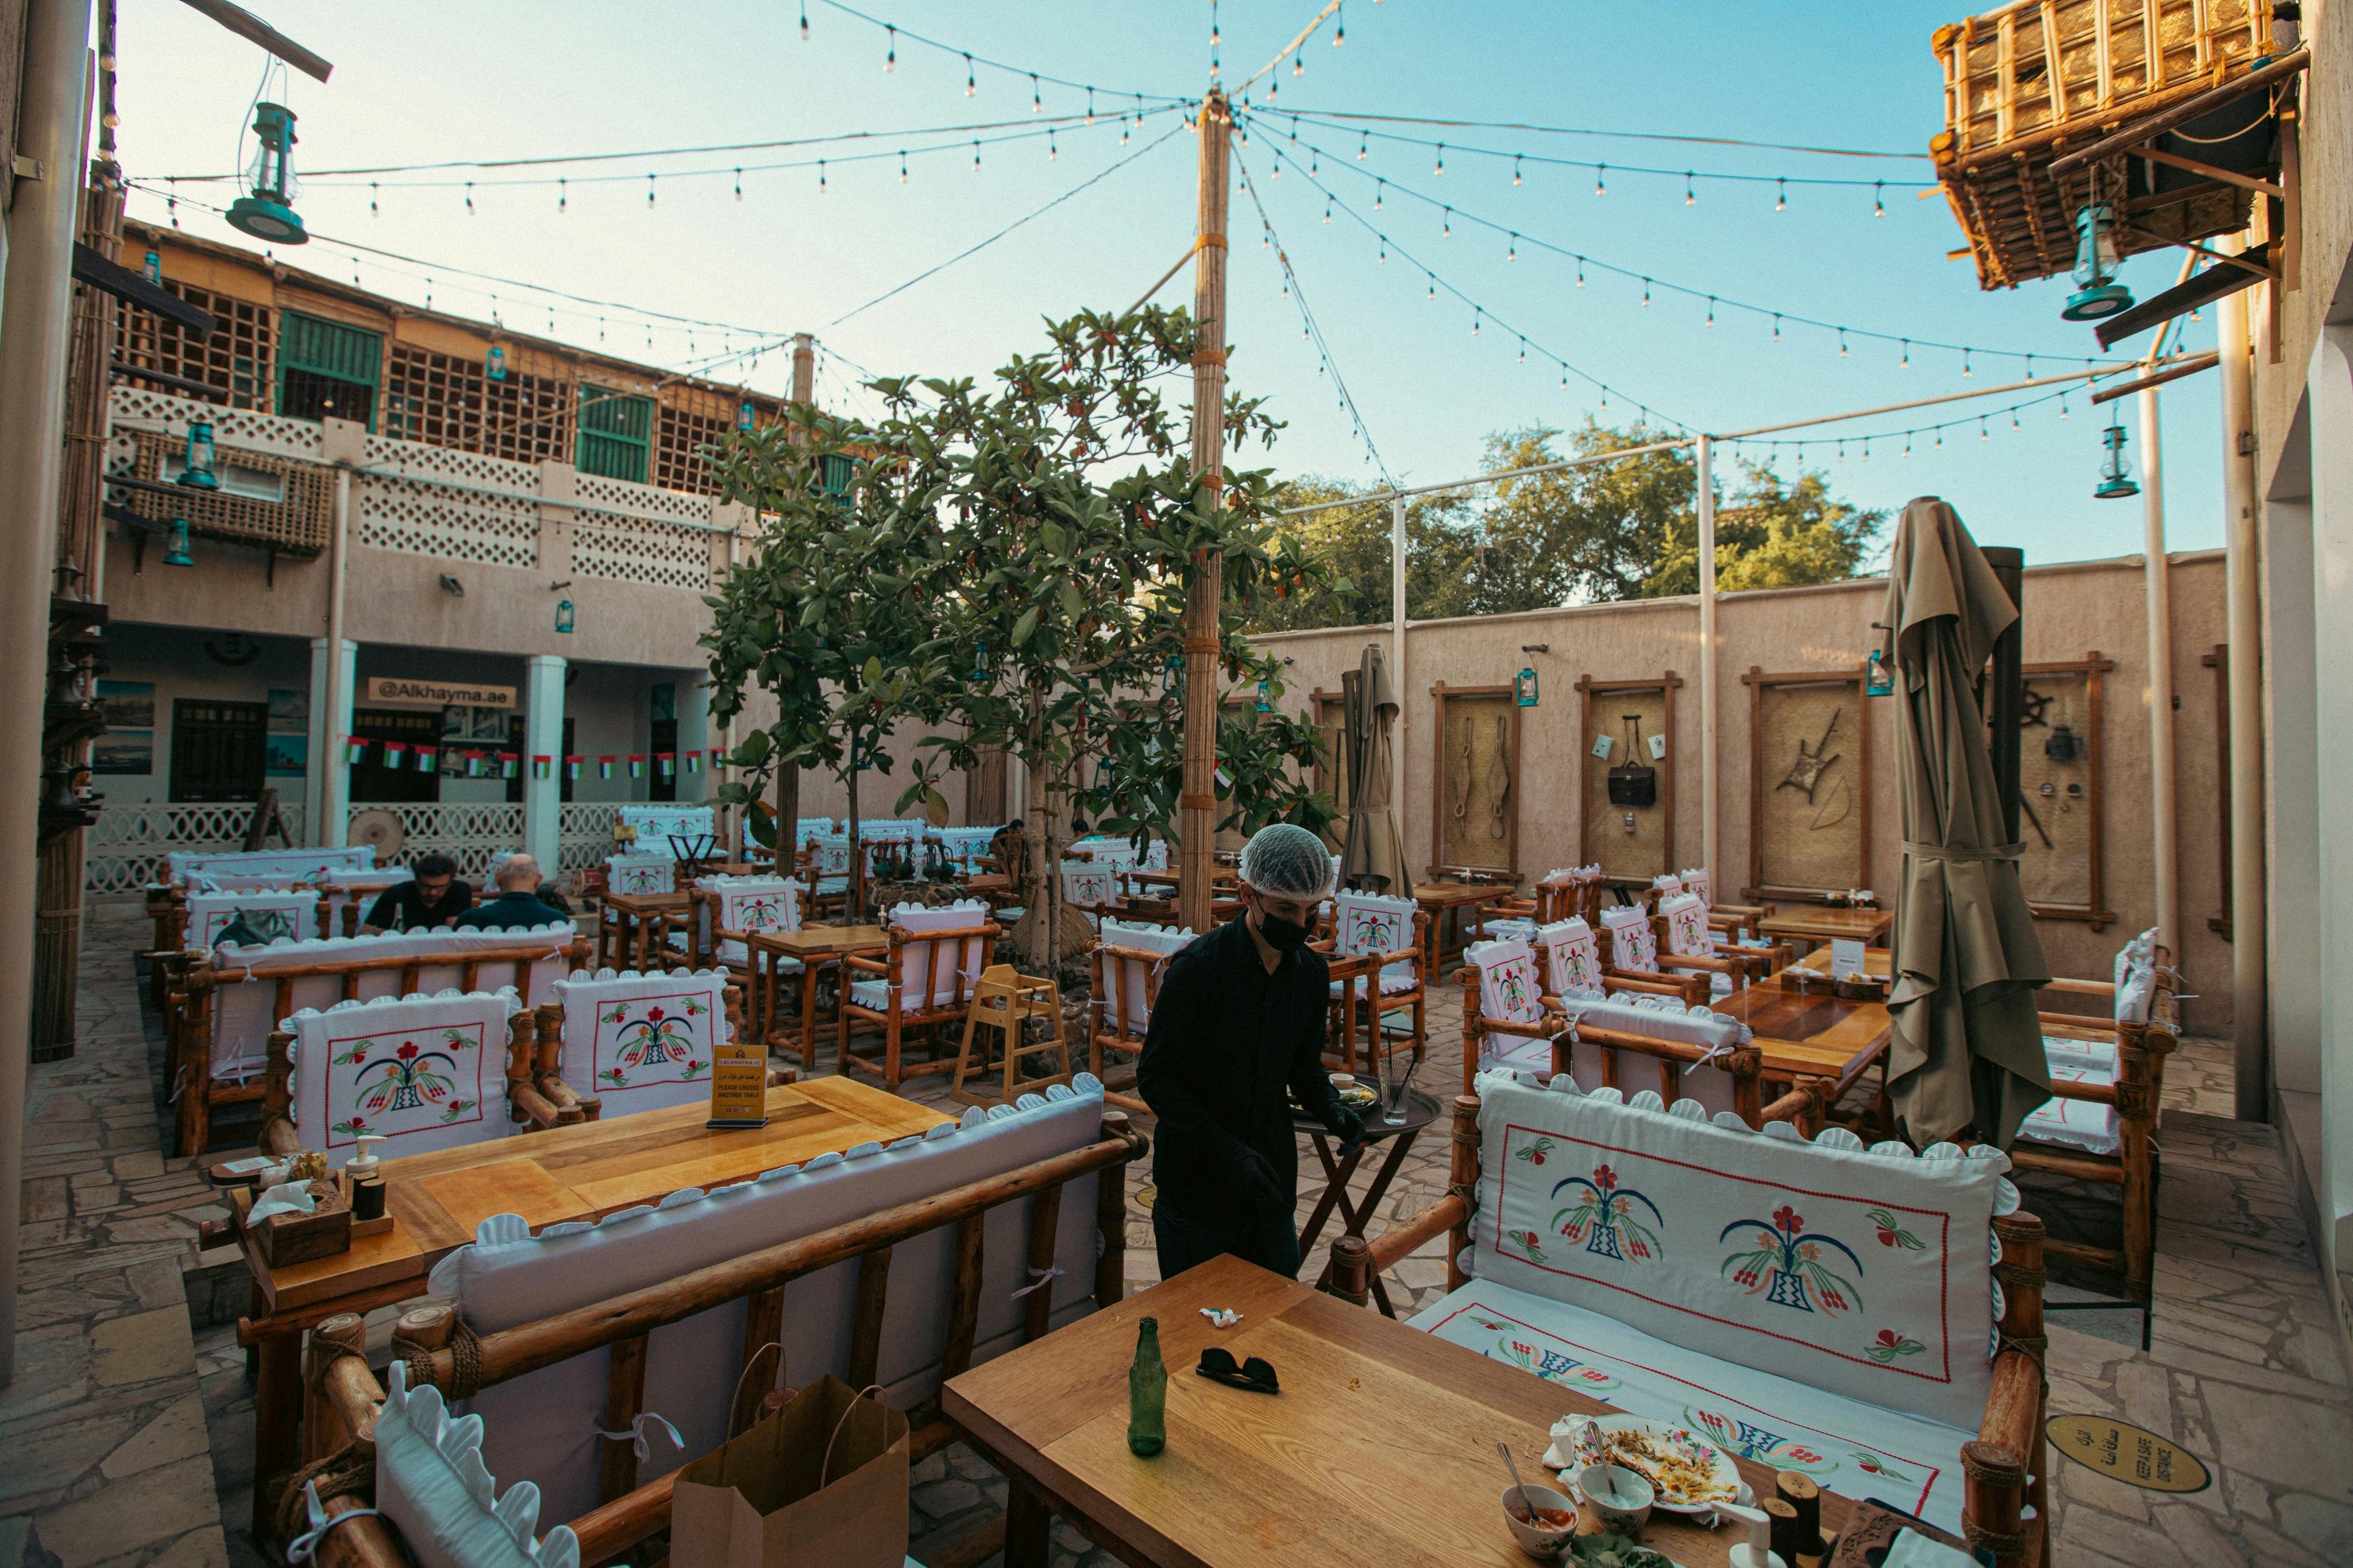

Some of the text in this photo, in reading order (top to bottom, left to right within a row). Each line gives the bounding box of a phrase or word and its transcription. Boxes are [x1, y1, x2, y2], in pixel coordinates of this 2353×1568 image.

[379, 681, 507, 706] @Alkhayma.ae
[2138, 1436, 2152, 1456] SAFE
[2136, 1460, 2151, 1480] KEEP
[2157, 1447, 2171, 1482] DISTANCE
